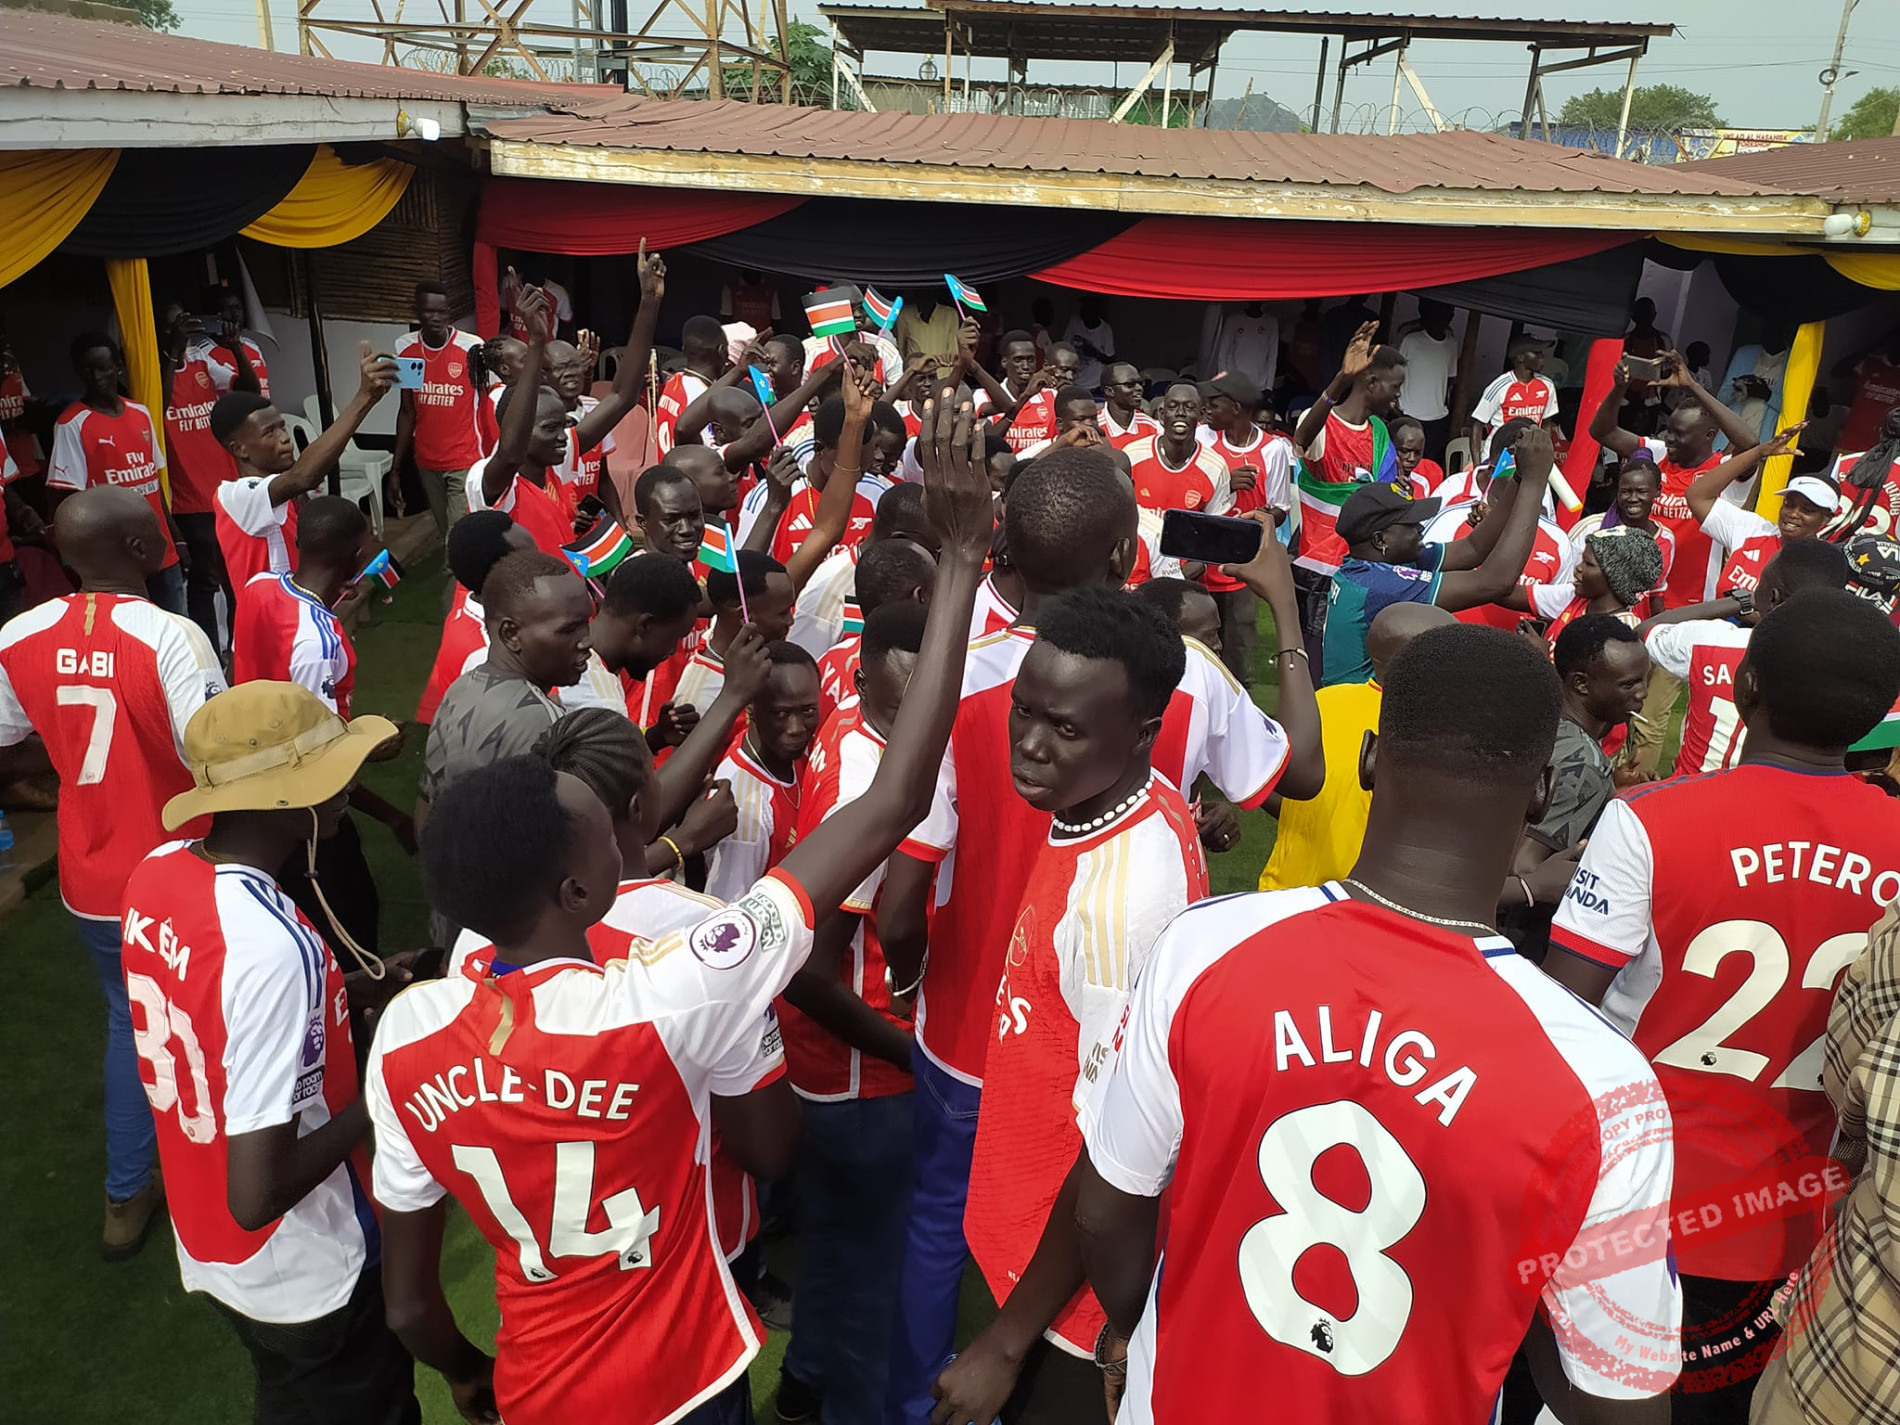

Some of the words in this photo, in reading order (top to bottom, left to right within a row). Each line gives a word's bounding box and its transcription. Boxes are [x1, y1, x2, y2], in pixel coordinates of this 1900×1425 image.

[166, 400, 217, 421] Emirate
[427, 394, 455, 407] BETTER
[179, 419, 193, 432] FLY
[126, 452, 145, 465] Fly
[57, 648, 115, 679] GABI
[56, 684, 118, 786] 7
[303, 1070, 323, 1088] room
[1273, 1004, 1479, 1128] ALIGA
[451, 1140, 662, 1283] 14
[1237, 1098, 1428, 1377] 8
